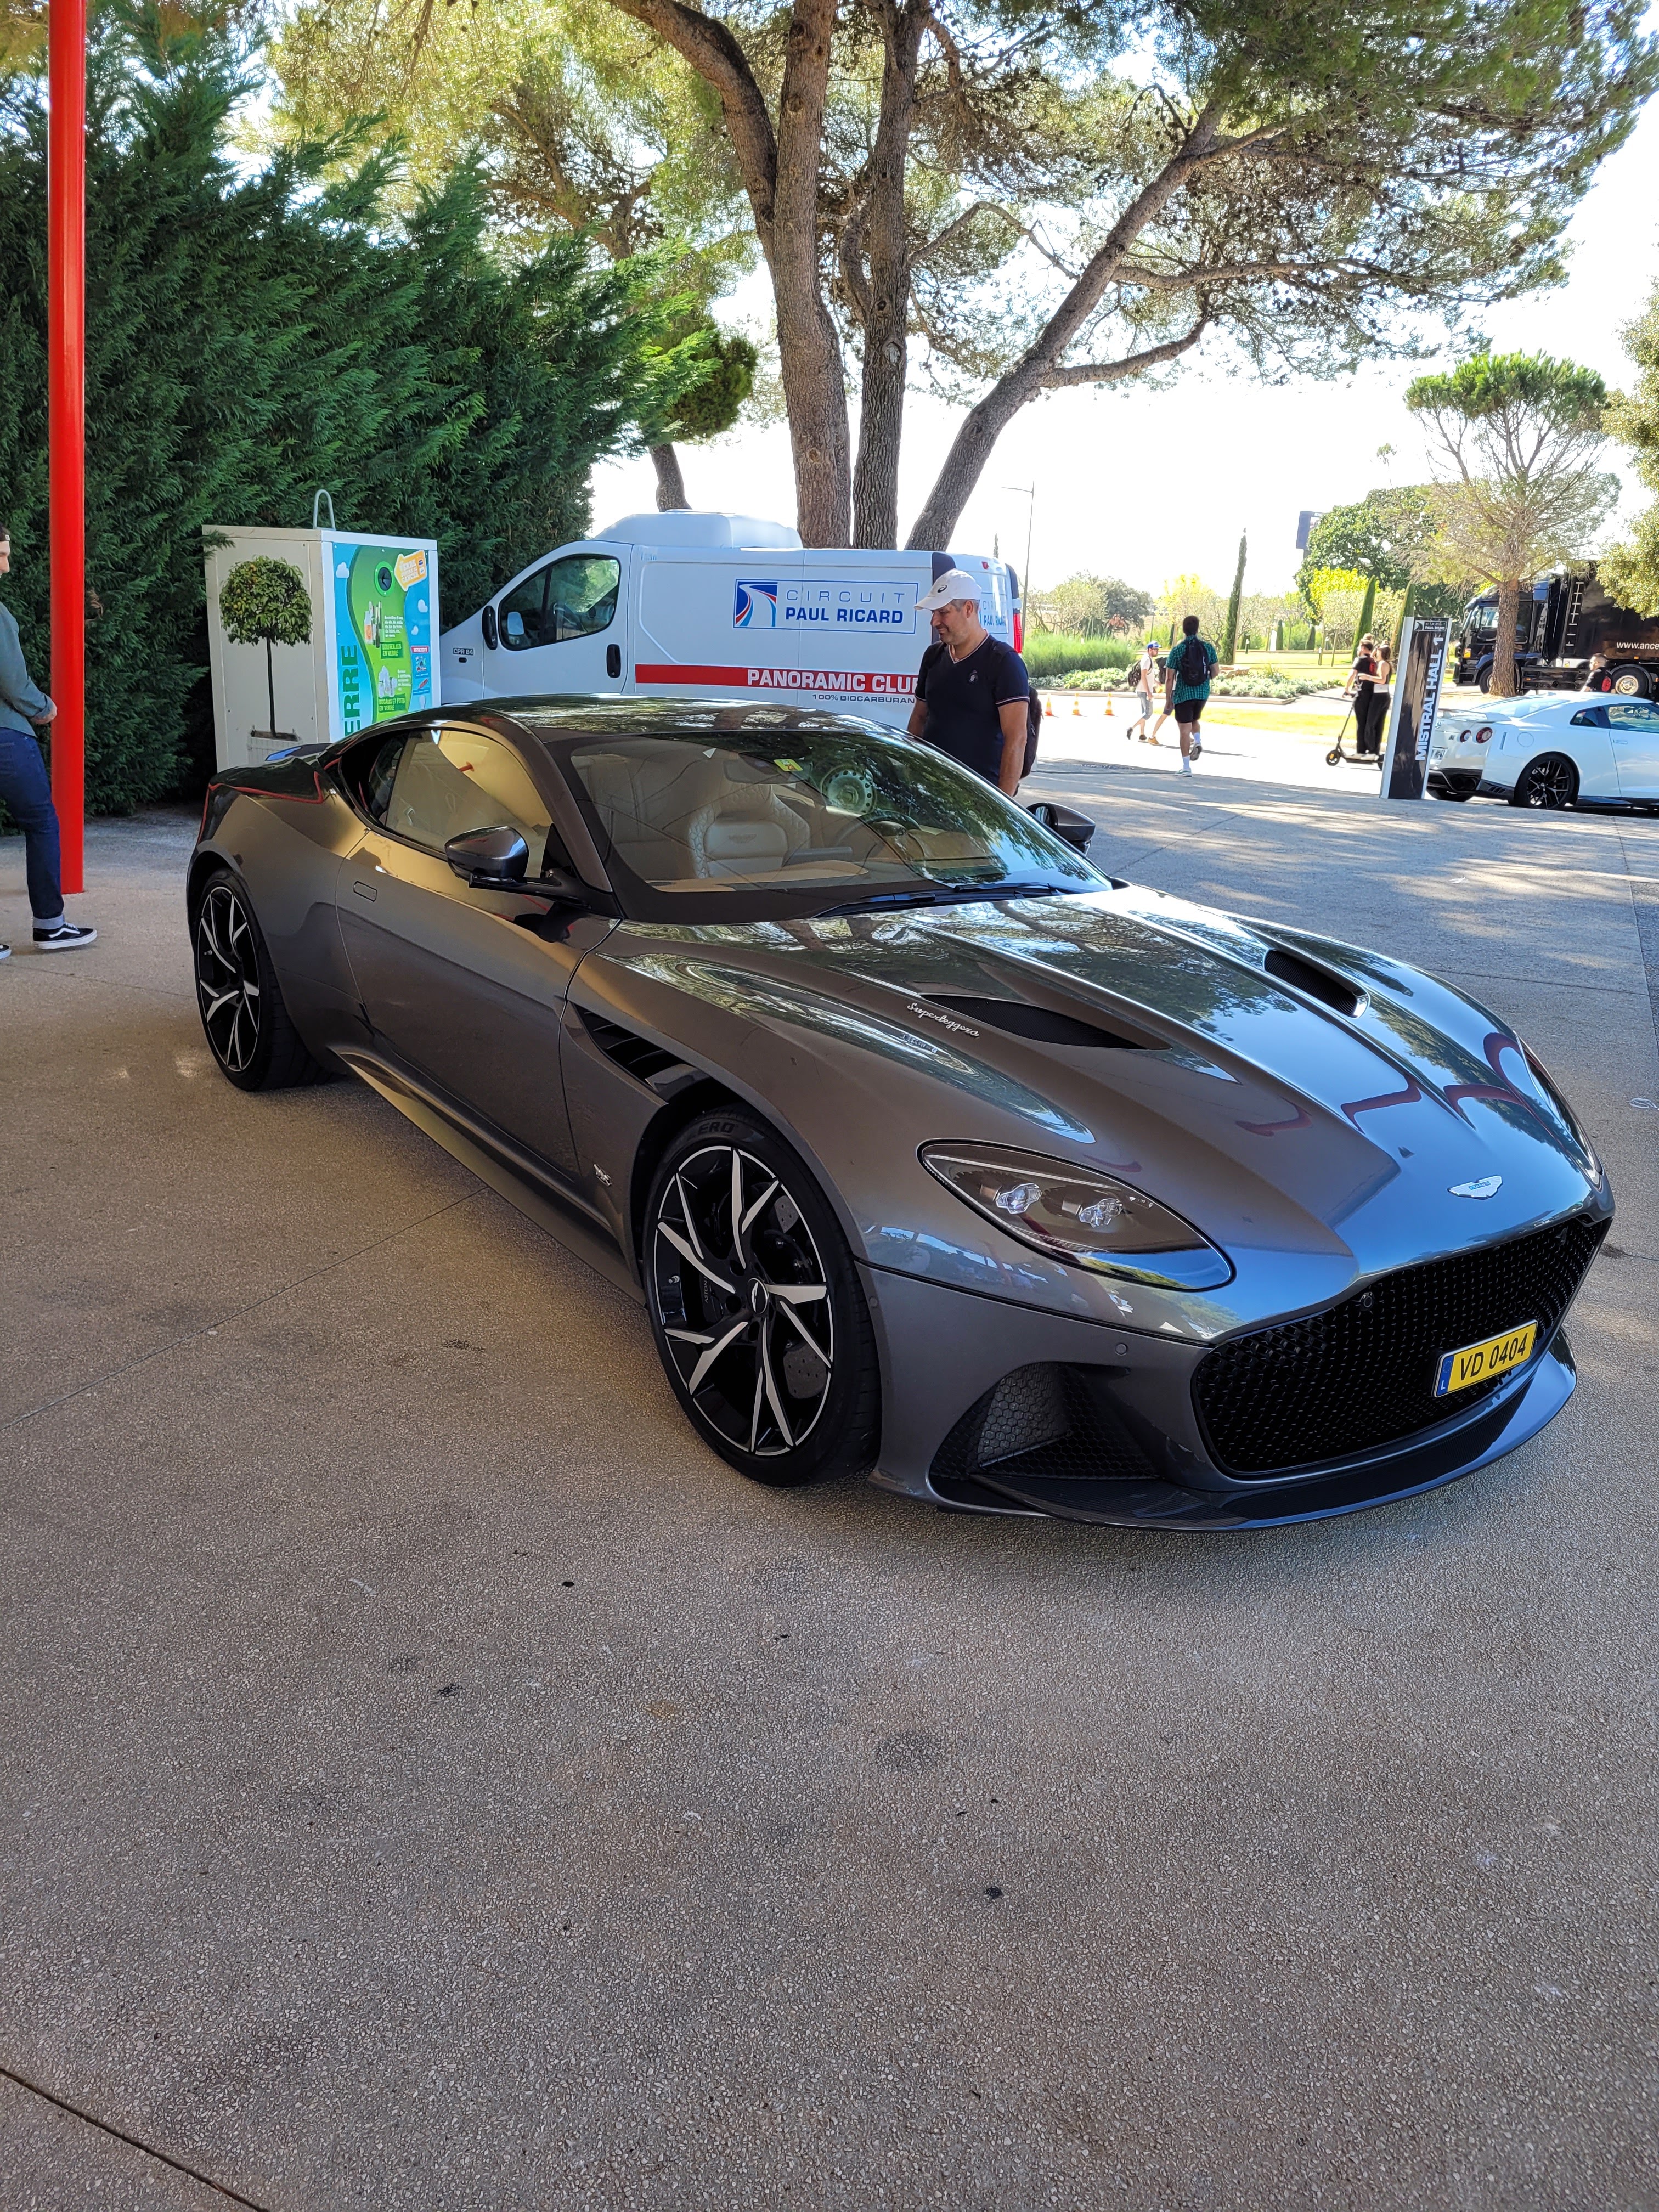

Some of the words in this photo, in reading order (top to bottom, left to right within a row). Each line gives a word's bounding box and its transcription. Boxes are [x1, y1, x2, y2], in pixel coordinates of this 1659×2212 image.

[787, 590, 905, 603] CIRCUIT
[786, 607, 829, 621] PAUL
[837, 608, 903, 623] RICARD
[1433, 637, 1444, 646] 1
[1426, 649, 1442, 690] HALL
[747, 669, 865, 691] PANORAMIC
[840, 695, 915, 704] BIOCARBURAN
[1415, 692, 1435, 761] MISTRAL
[907, 1002, 979, 1037] Superleggera
[1461, 1352, 1484, 1381] VD
[1489, 1332, 1528, 1370] 0404
[1441, 1380, 1446, 1390] L
